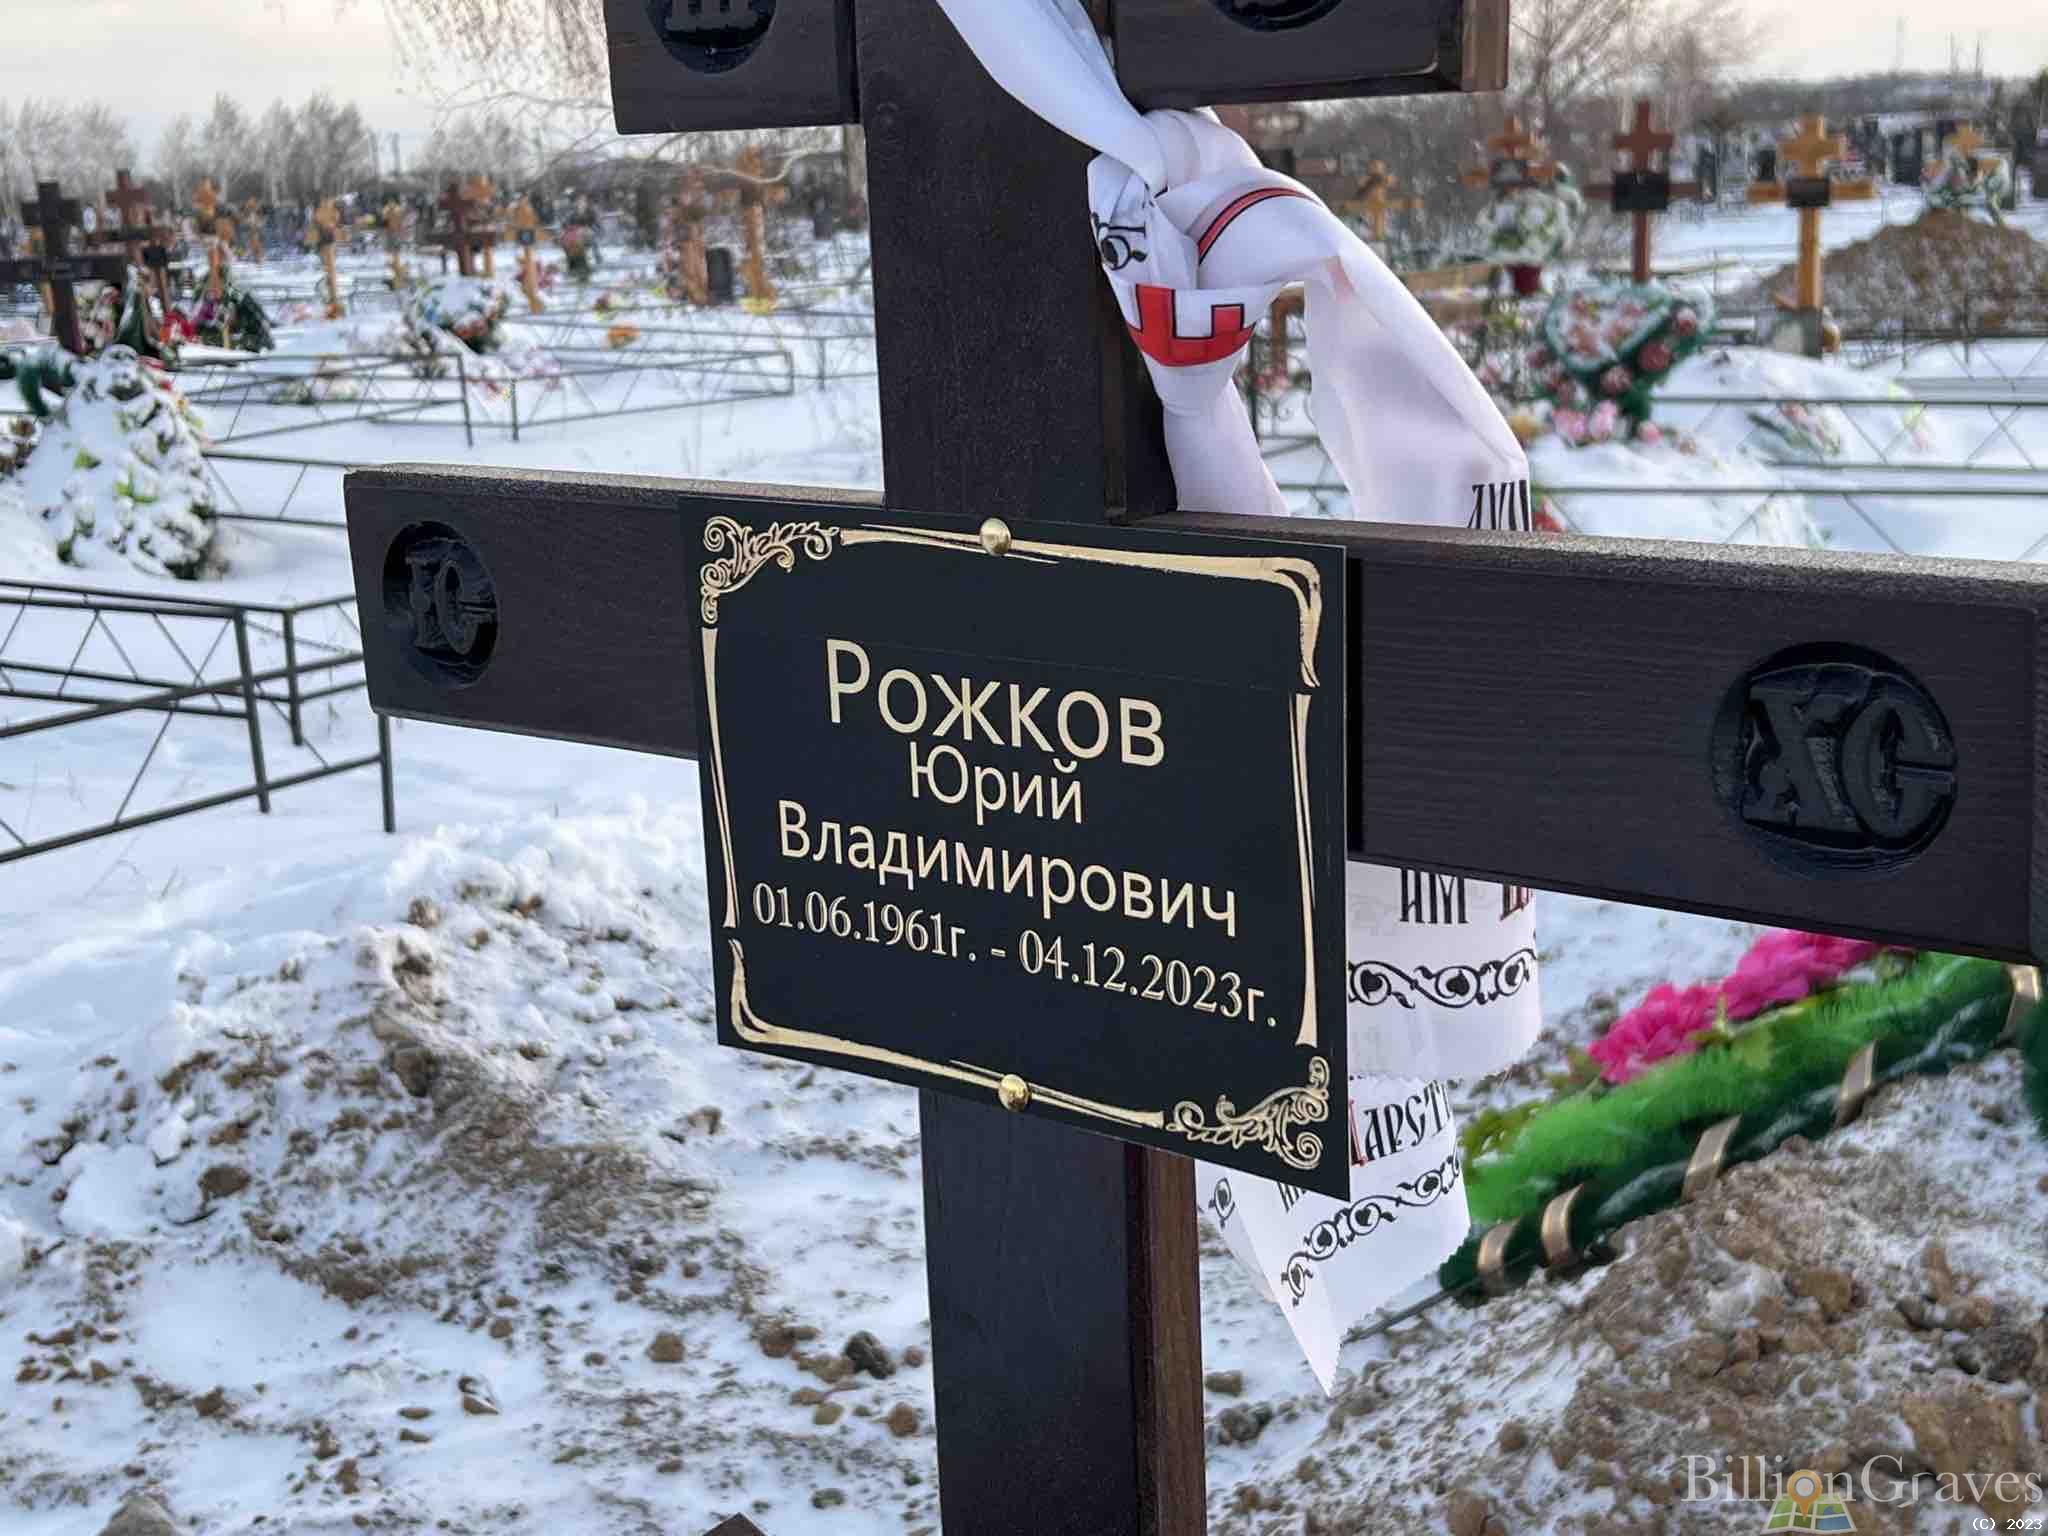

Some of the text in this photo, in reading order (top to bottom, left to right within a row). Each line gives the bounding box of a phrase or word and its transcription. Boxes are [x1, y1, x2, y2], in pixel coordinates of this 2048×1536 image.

[908, 740, 1084, 825] Юрий
[777, 798, 1238, 938] Владимирович
[752, 881, 978, 962] 01.06.1961г.
[1018, 928, 1278, 1028] 04.12.2023г.
